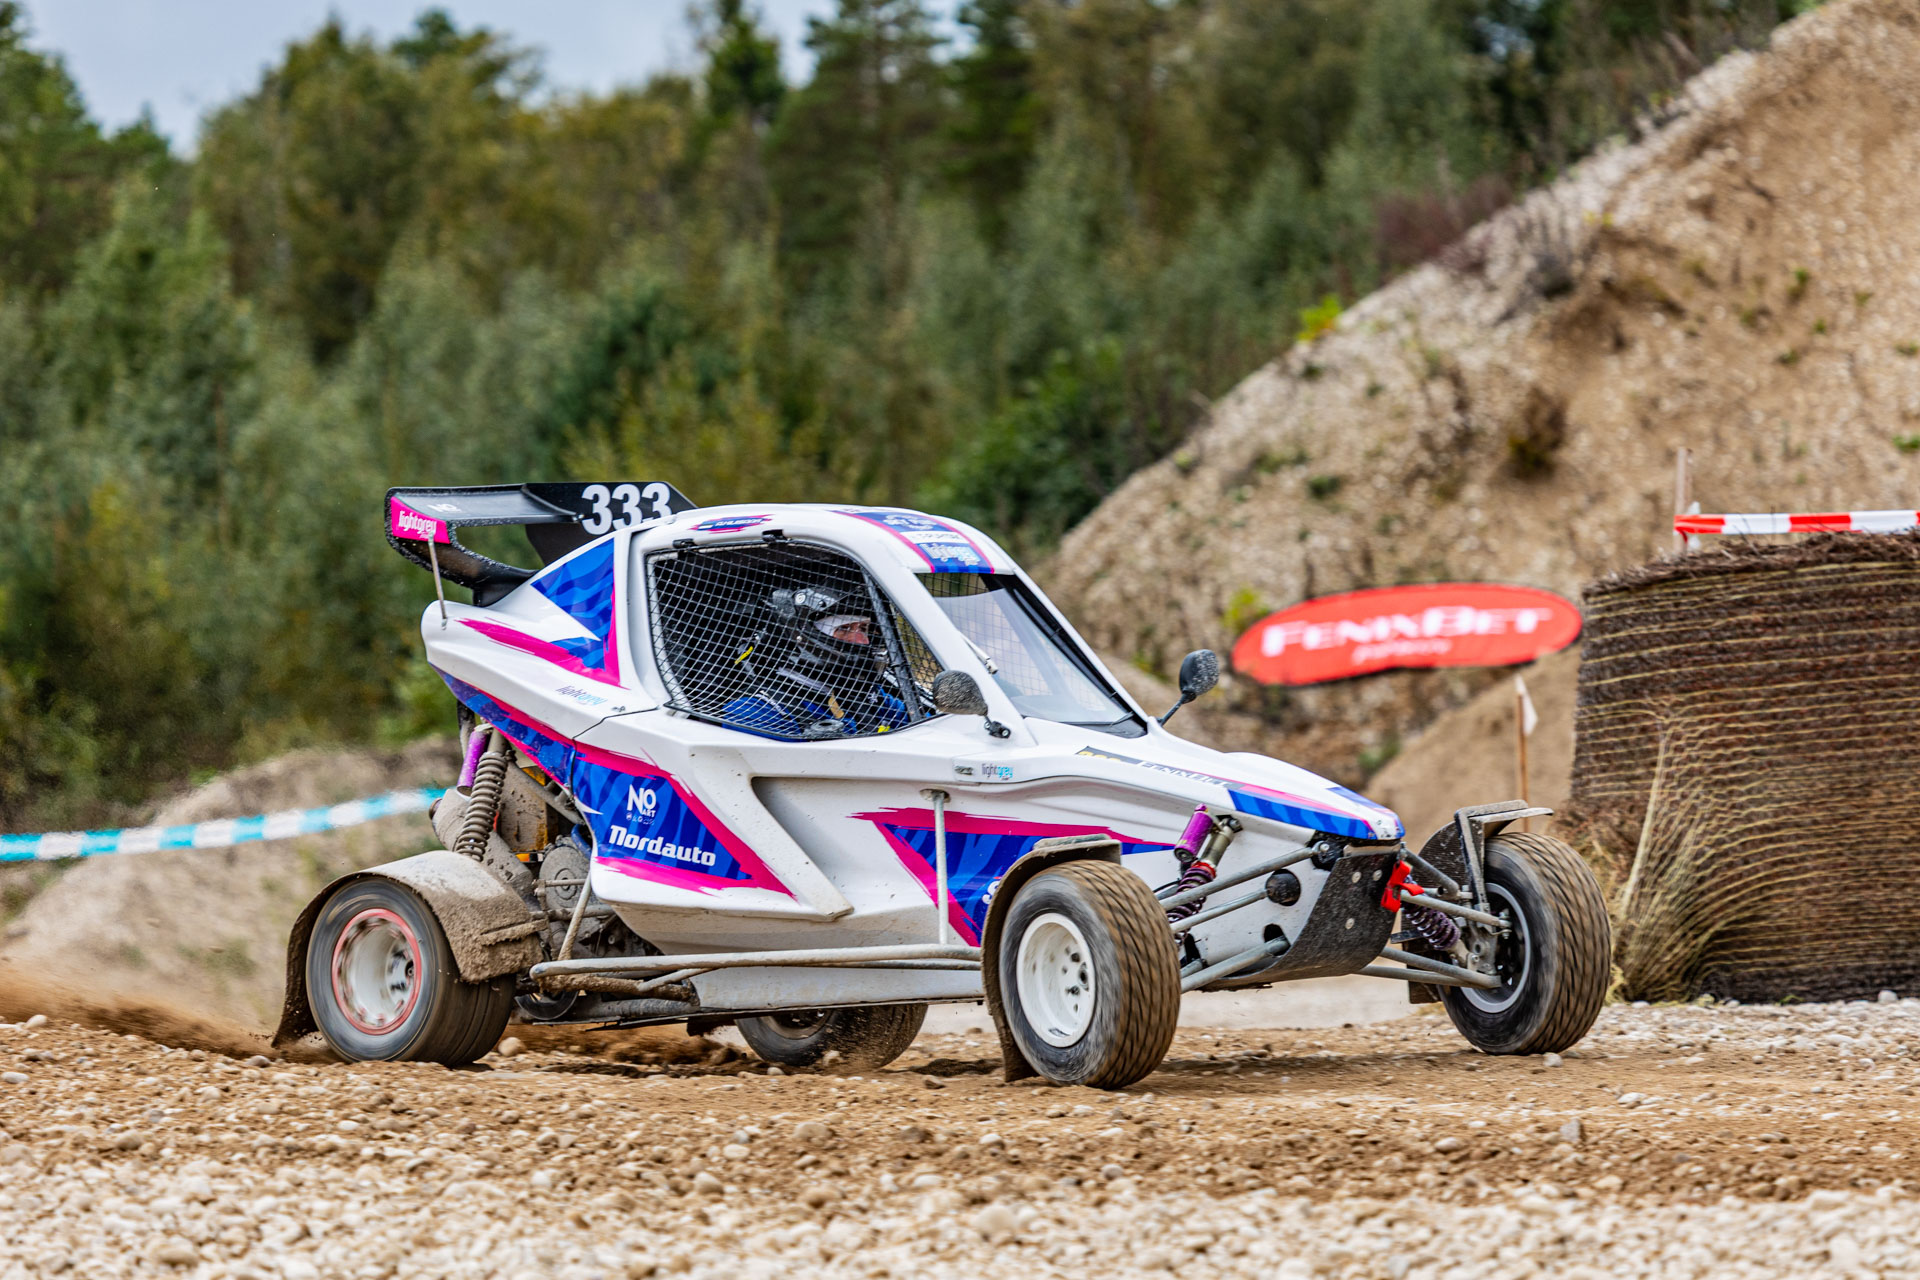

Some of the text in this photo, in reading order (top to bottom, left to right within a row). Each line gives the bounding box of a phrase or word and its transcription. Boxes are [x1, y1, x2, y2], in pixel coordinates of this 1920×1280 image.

[398, 510, 438, 535] lightgrey
[581, 482, 673, 535] 333
[1261, 605, 1553, 658] FENIXBET
[626, 784, 657, 815] NO
[641, 808, 657, 818] ART
